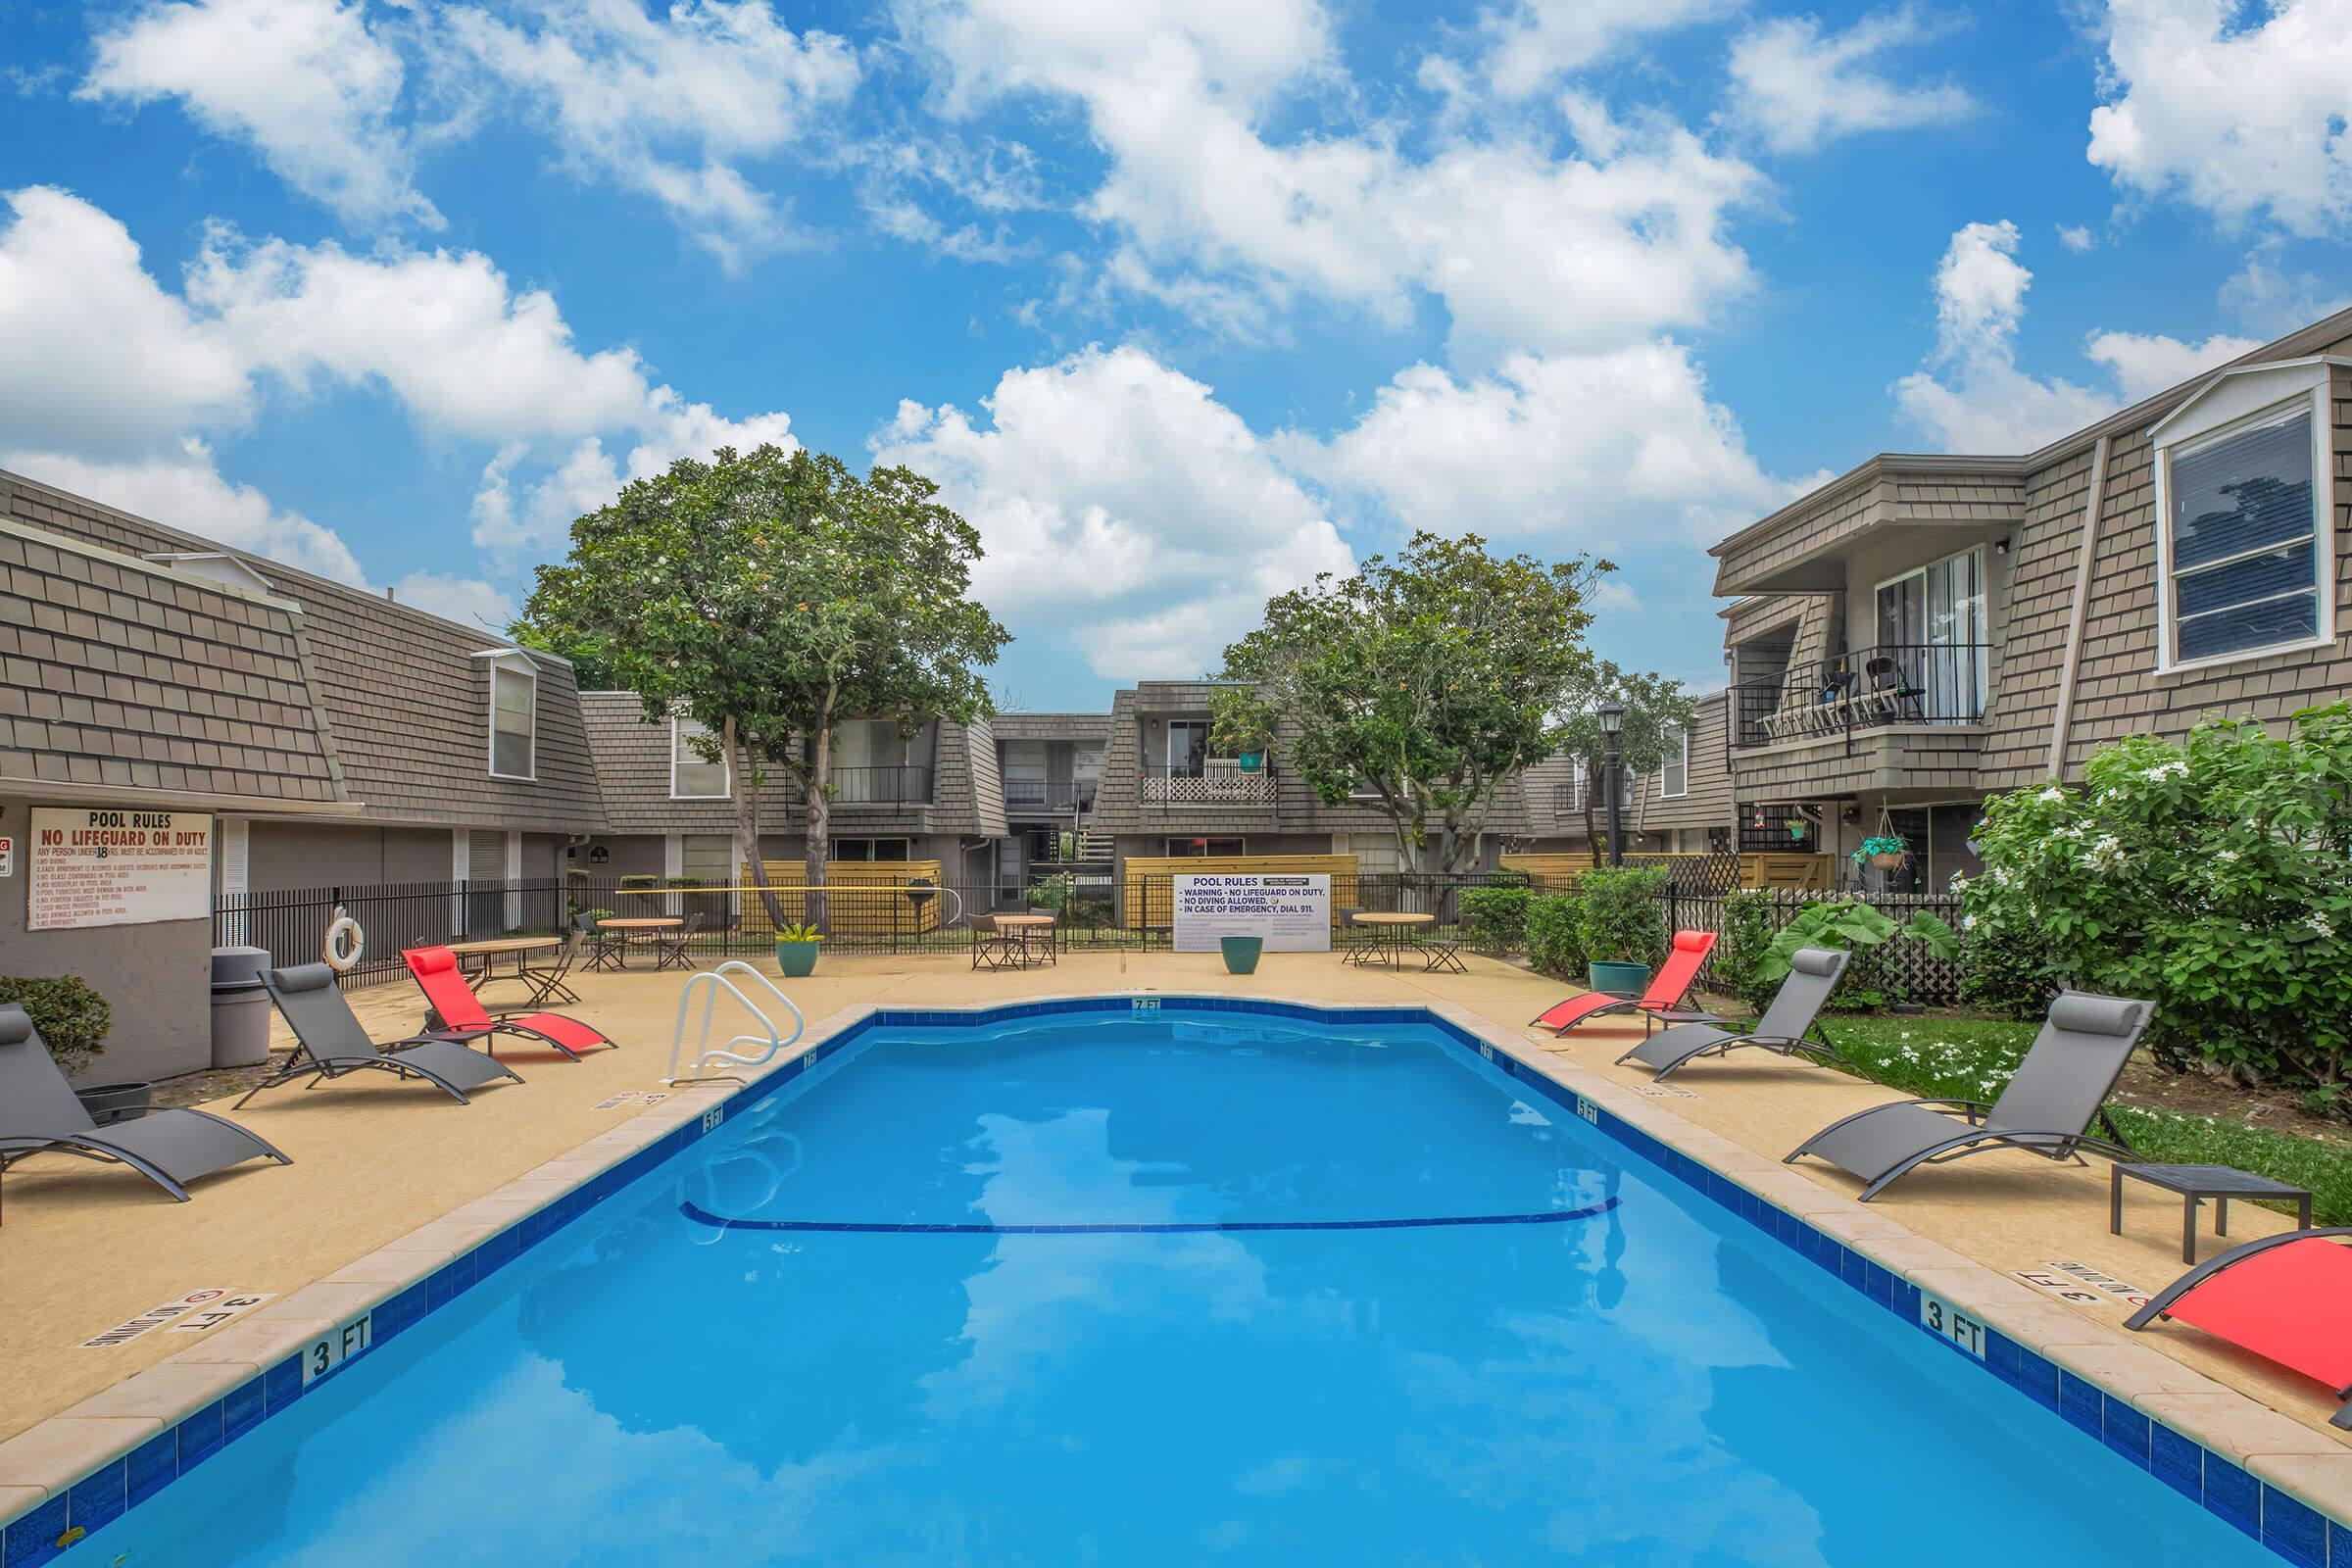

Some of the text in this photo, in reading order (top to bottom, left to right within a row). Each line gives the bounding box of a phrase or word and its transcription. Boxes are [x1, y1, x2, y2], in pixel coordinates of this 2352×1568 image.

[89, 812, 172, 828] POOL RULES
[42, 829, 206, 847] NO LIFEGUARD ON DUTY
[96, 846, 108, 858] 18
[1193, 878, 1222, 887] POOL
[1225, 878, 1257, 887] RULES
[1229, 906, 1279, 914] EMERGENCY,
[1137, 1000, 1160, 1011] 7 FT
[706, 1106, 722, 1130] 5 FT
[1580, 1100, 1596, 1124] 5 FT
[2016, 1272, 2098, 1301] 3 FT
[2049, 1262, 2141, 1294] NO DIVING
[178, 1297, 261, 1331] 3 FT
[83, 1305, 190, 1348] NO DIVING
[1928, 1300, 1982, 1354] 3 FT
[313, 1315, 369, 1376] 3 FT
